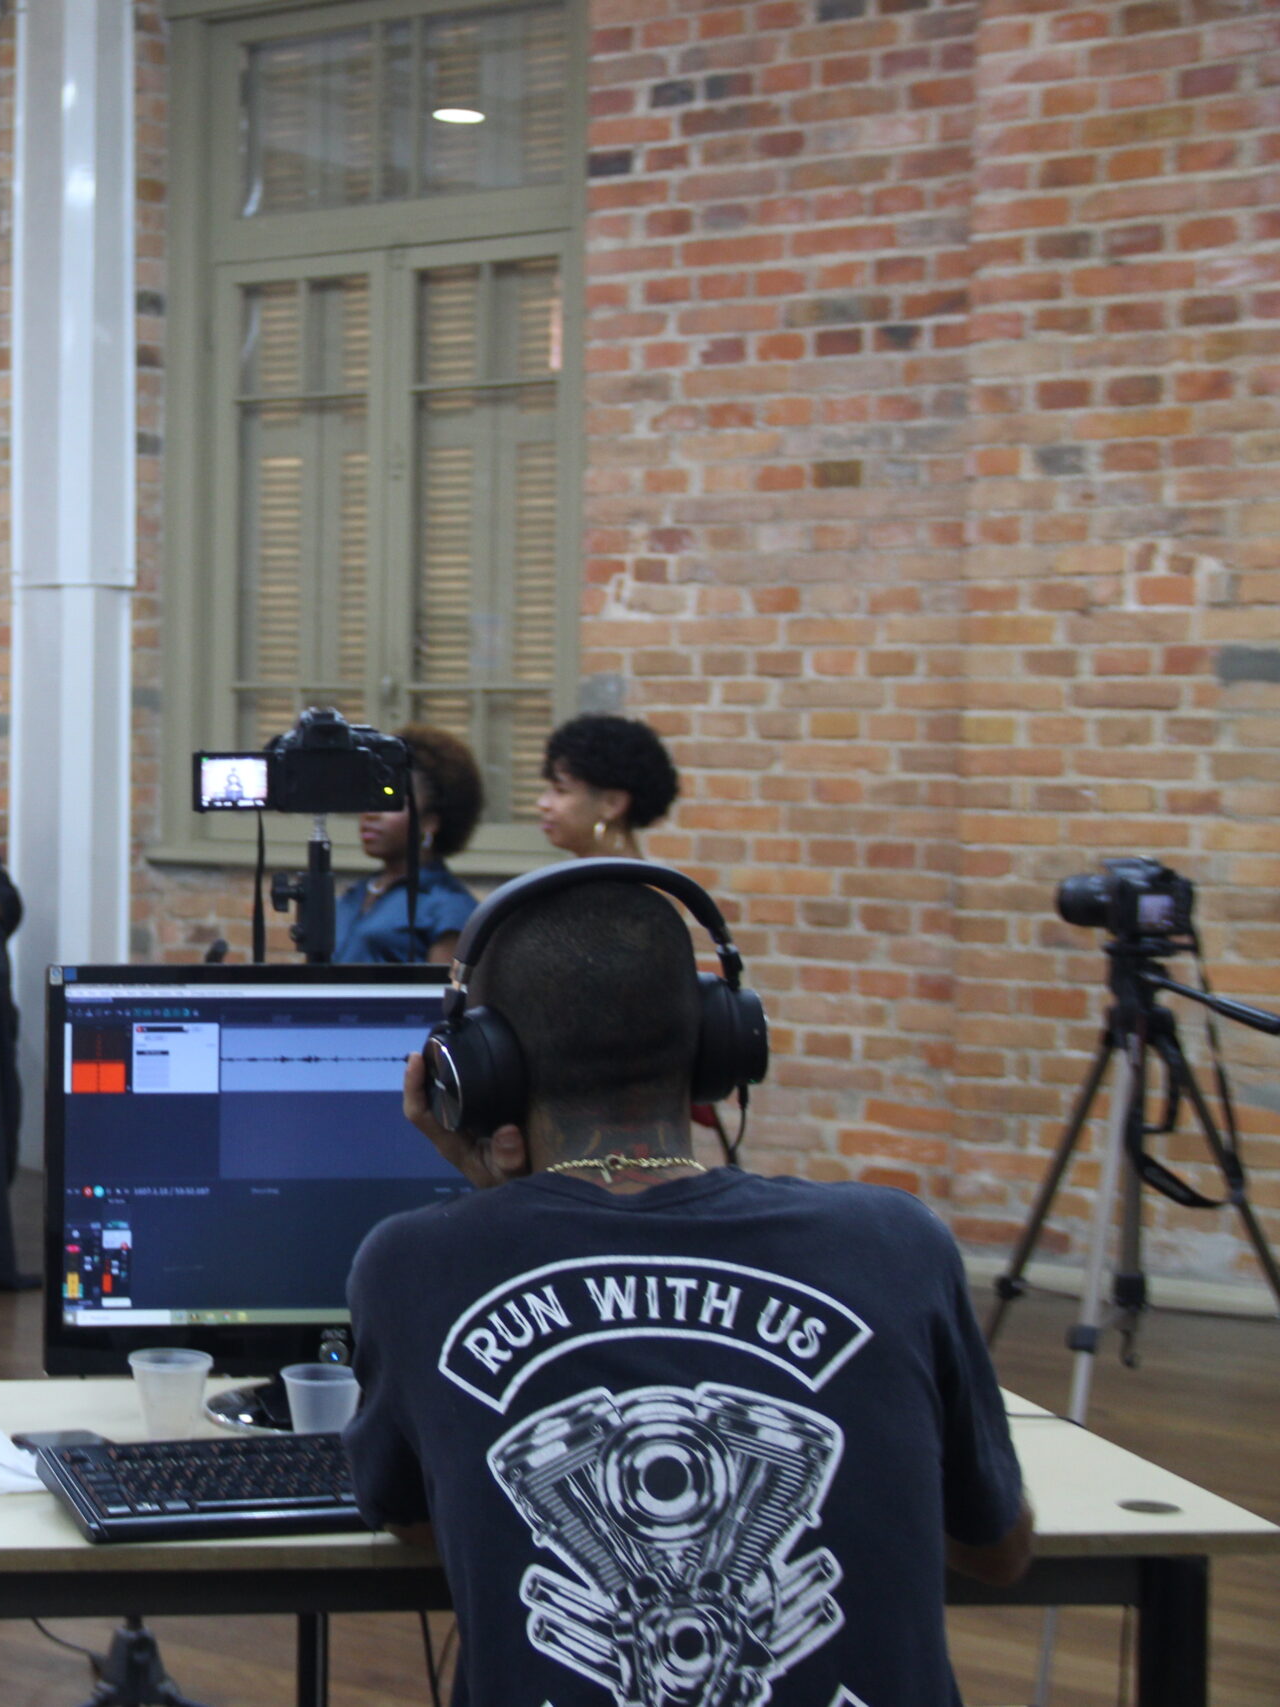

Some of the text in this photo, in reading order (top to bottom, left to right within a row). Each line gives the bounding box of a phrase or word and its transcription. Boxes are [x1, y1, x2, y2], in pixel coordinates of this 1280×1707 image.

[463, 1275, 828, 1375] RUN WITH US
